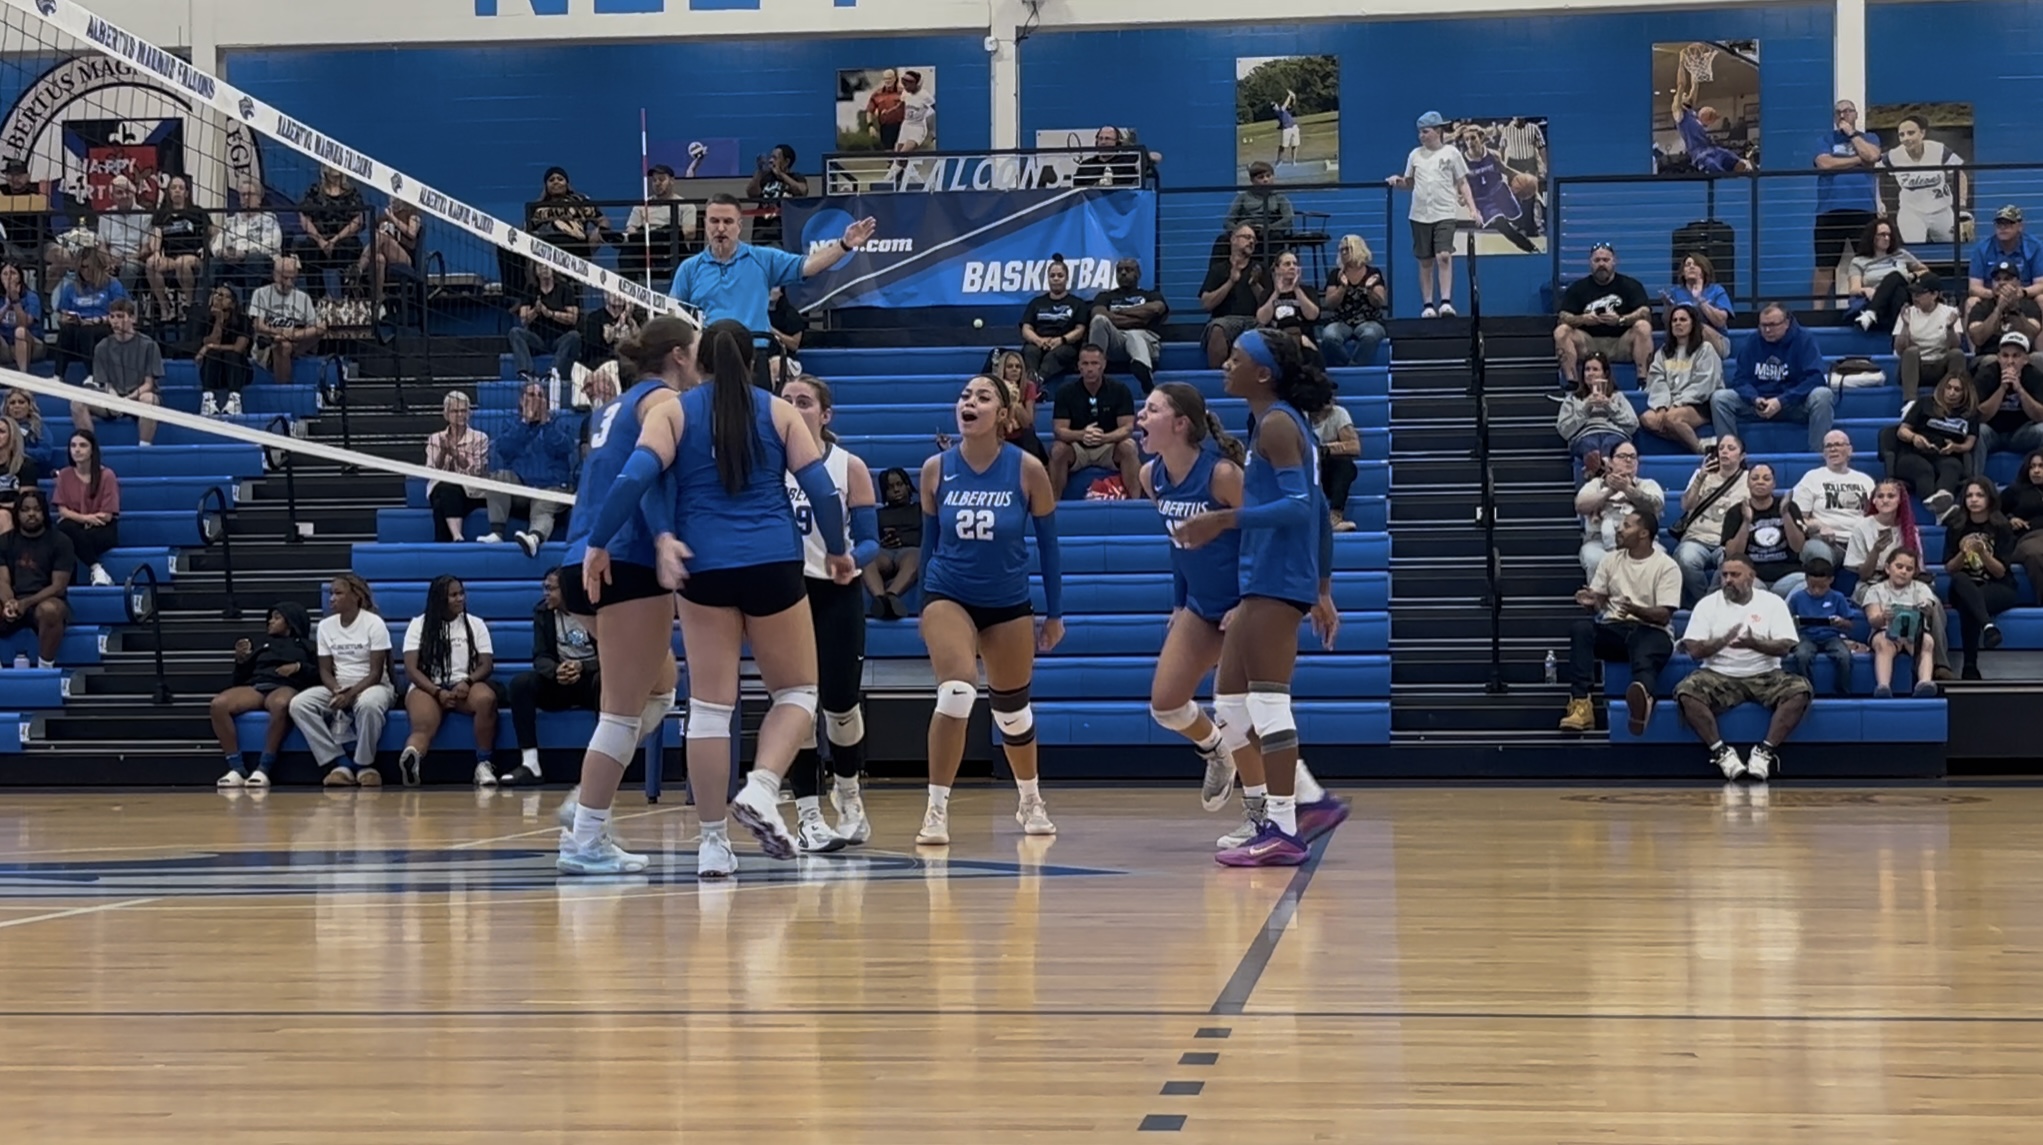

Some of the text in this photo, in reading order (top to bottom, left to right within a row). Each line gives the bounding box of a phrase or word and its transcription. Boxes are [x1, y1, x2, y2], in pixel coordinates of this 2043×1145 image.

[86, 15, 136, 60] ALBERTUS
[177, 62, 216, 101] FALCONS
[899, 156, 1064, 193] FALCONS
[1900, 173, 1942, 191] Falcons
[1932, 183, 1951, 199] 20
[591, 402, 622, 449] 3
[943, 490, 1014, 507] ALBERTUS
[1158, 500, 1209, 517] LBERTUS
[955, 509, 995, 541] 22
